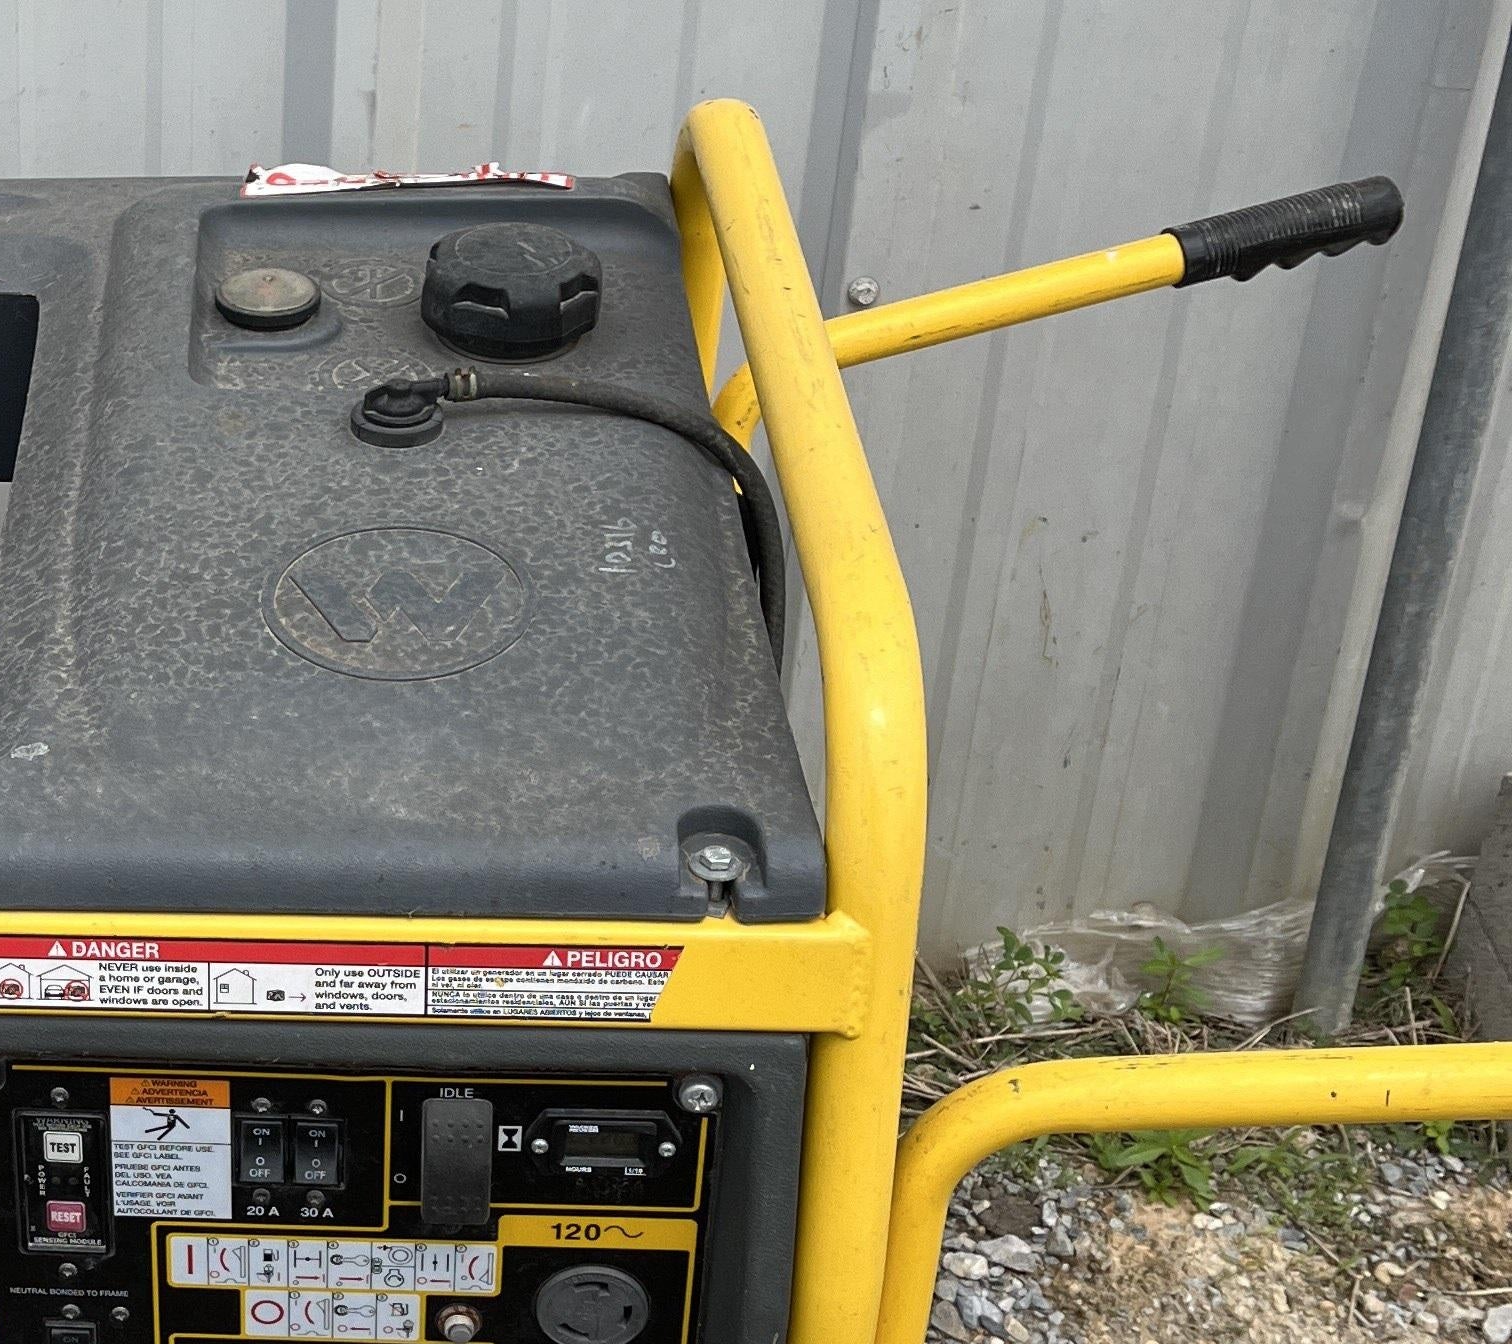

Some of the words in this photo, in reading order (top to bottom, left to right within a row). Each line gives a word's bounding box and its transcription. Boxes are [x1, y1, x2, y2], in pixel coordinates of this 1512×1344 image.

[72, 941, 159, 959] DANGER
[567, 951, 662, 967] PELIGRO
[98, 962, 138, 972] NEVER
[164, 964, 197, 973] inside
[314, 968, 340, 979] Only
[367, 969, 420, 978] OUTSIDE
[108, 973, 140, 982] home
[157, 976, 199, 985] garage,
[99, 985, 130, 994] EVEN
[133, 986, 143, 994] IF
[146, 986, 179, 995] doors
[182, 987, 203, 995] and
[314, 979, 336, 988] and
[339, 979, 354, 988] far
[357, 982, 386, 991] away
[390, 980, 416, 989] from
[314, 990, 368, 1001] windows,
[371, 991, 406, 1002] doors,
[99, 996, 148, 1005] windows
[171, 999, 200, 1008] open.
[314, 1002, 336, 1010] and
[151, 1080, 197, 1088] WARNING
[141, 1088, 208, 1097] ADVERTENCIA
[439, 1088, 474, 1098] IDLE
[136, 1096, 214, 1106] AVERTISSEMENT
[252, 1128, 270, 1136] ON
[308, 1129, 326, 1138] ON
[49, 1142, 76, 1154] TEST
[249, 1168, 271, 1178] OFF
[304, 1170, 326, 1180] OFF
[83, 1166, 91, 1197] FAULT
[115, 1180, 171, 1188] CALCOMANIA
[186, 1181, 207, 1189] GFCI.
[116, 1208, 177, 1216] AUTOCOLLANT
[193, 1209, 215, 1217] GFCI.
[246, 1206, 265, 1216] 20
[268, 1206, 280, 1216] A
[300, 1207, 319, 1217] 30
[322, 1208, 334, 1218] A
[50, 1211, 81, 1223] RESET
[9, 1287, 48, 1296] NEUTRAL
[49, 1288, 85, 1297] BONDED
[86, 1289, 98, 1297] TO
[99, 1289, 129, 1298] FRAME
